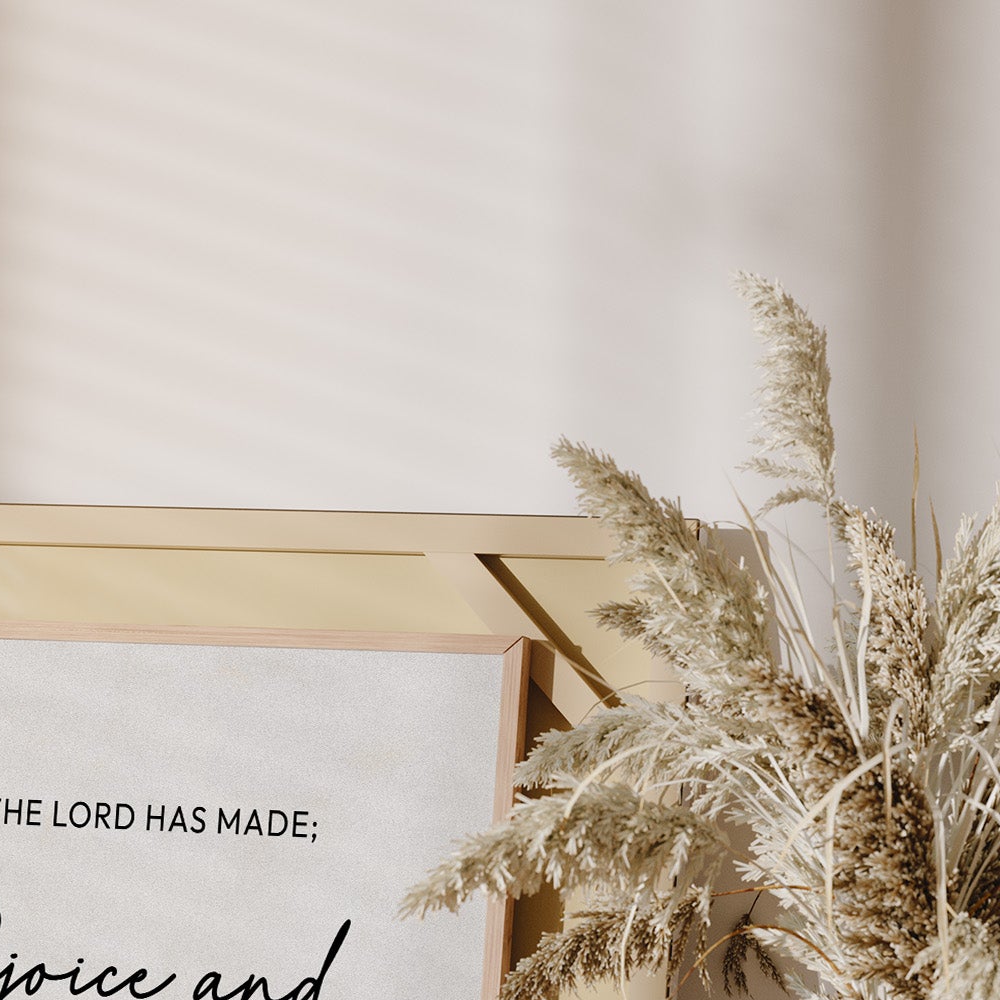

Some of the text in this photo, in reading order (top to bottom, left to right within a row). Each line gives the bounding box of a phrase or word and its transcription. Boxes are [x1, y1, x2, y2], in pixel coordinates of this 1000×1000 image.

[52, 801, 135, 830] LORD
[146, 804, 207, 834] HAS
[217, 807, 318, 844] MADE;
